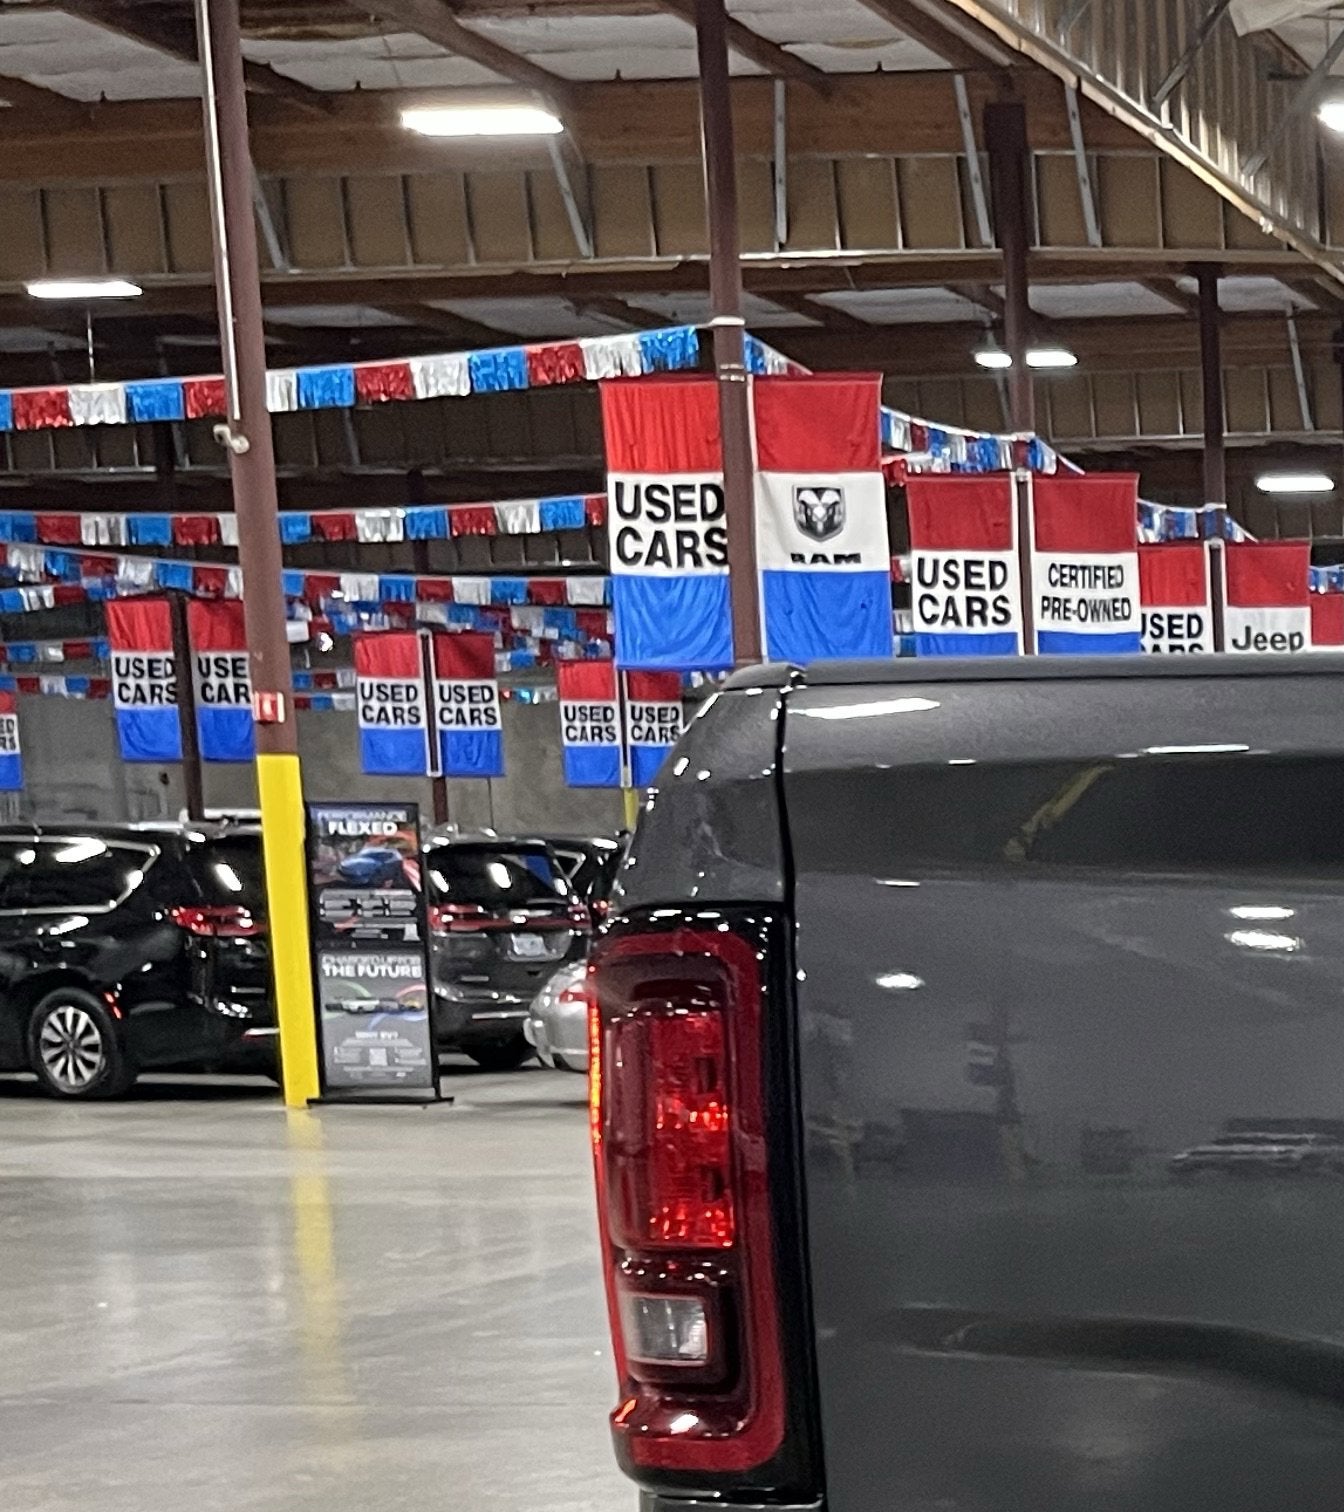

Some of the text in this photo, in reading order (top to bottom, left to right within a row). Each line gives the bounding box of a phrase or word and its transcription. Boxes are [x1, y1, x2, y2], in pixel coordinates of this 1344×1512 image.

[614, 481, 725, 523] USED
[616, 526, 729, 568] CARS
[790, 553, 862, 565] RAM
[917, 557, 1008, 590] USED
[1048, 563, 1124, 589] CERTIFIED
[918, 593, 1012, 627] CARS
[1041, 595, 1132, 623] PRE-OWNED
[1232, 625, 1304, 651] Jeep
[115, 657, 175, 679] USED
[198, 657, 247, 679] USE
[117, 682, 177, 704] CARS
[200, 682, 251, 704] CAR
[360, 683, 418, 702] USED
[438, 684, 498, 704] USED
[361, 705, 421, 725] CARS
[439, 706, 498, 727] CARS
[564, 704, 615, 723] USED
[630, 705, 679, 723] USED
[565, 725, 617, 743] CARS
[631, 725, 681, 743] CARS
[328, 821, 398, 836] FLEXED
[322, 963, 422, 978] THE FUTURE
